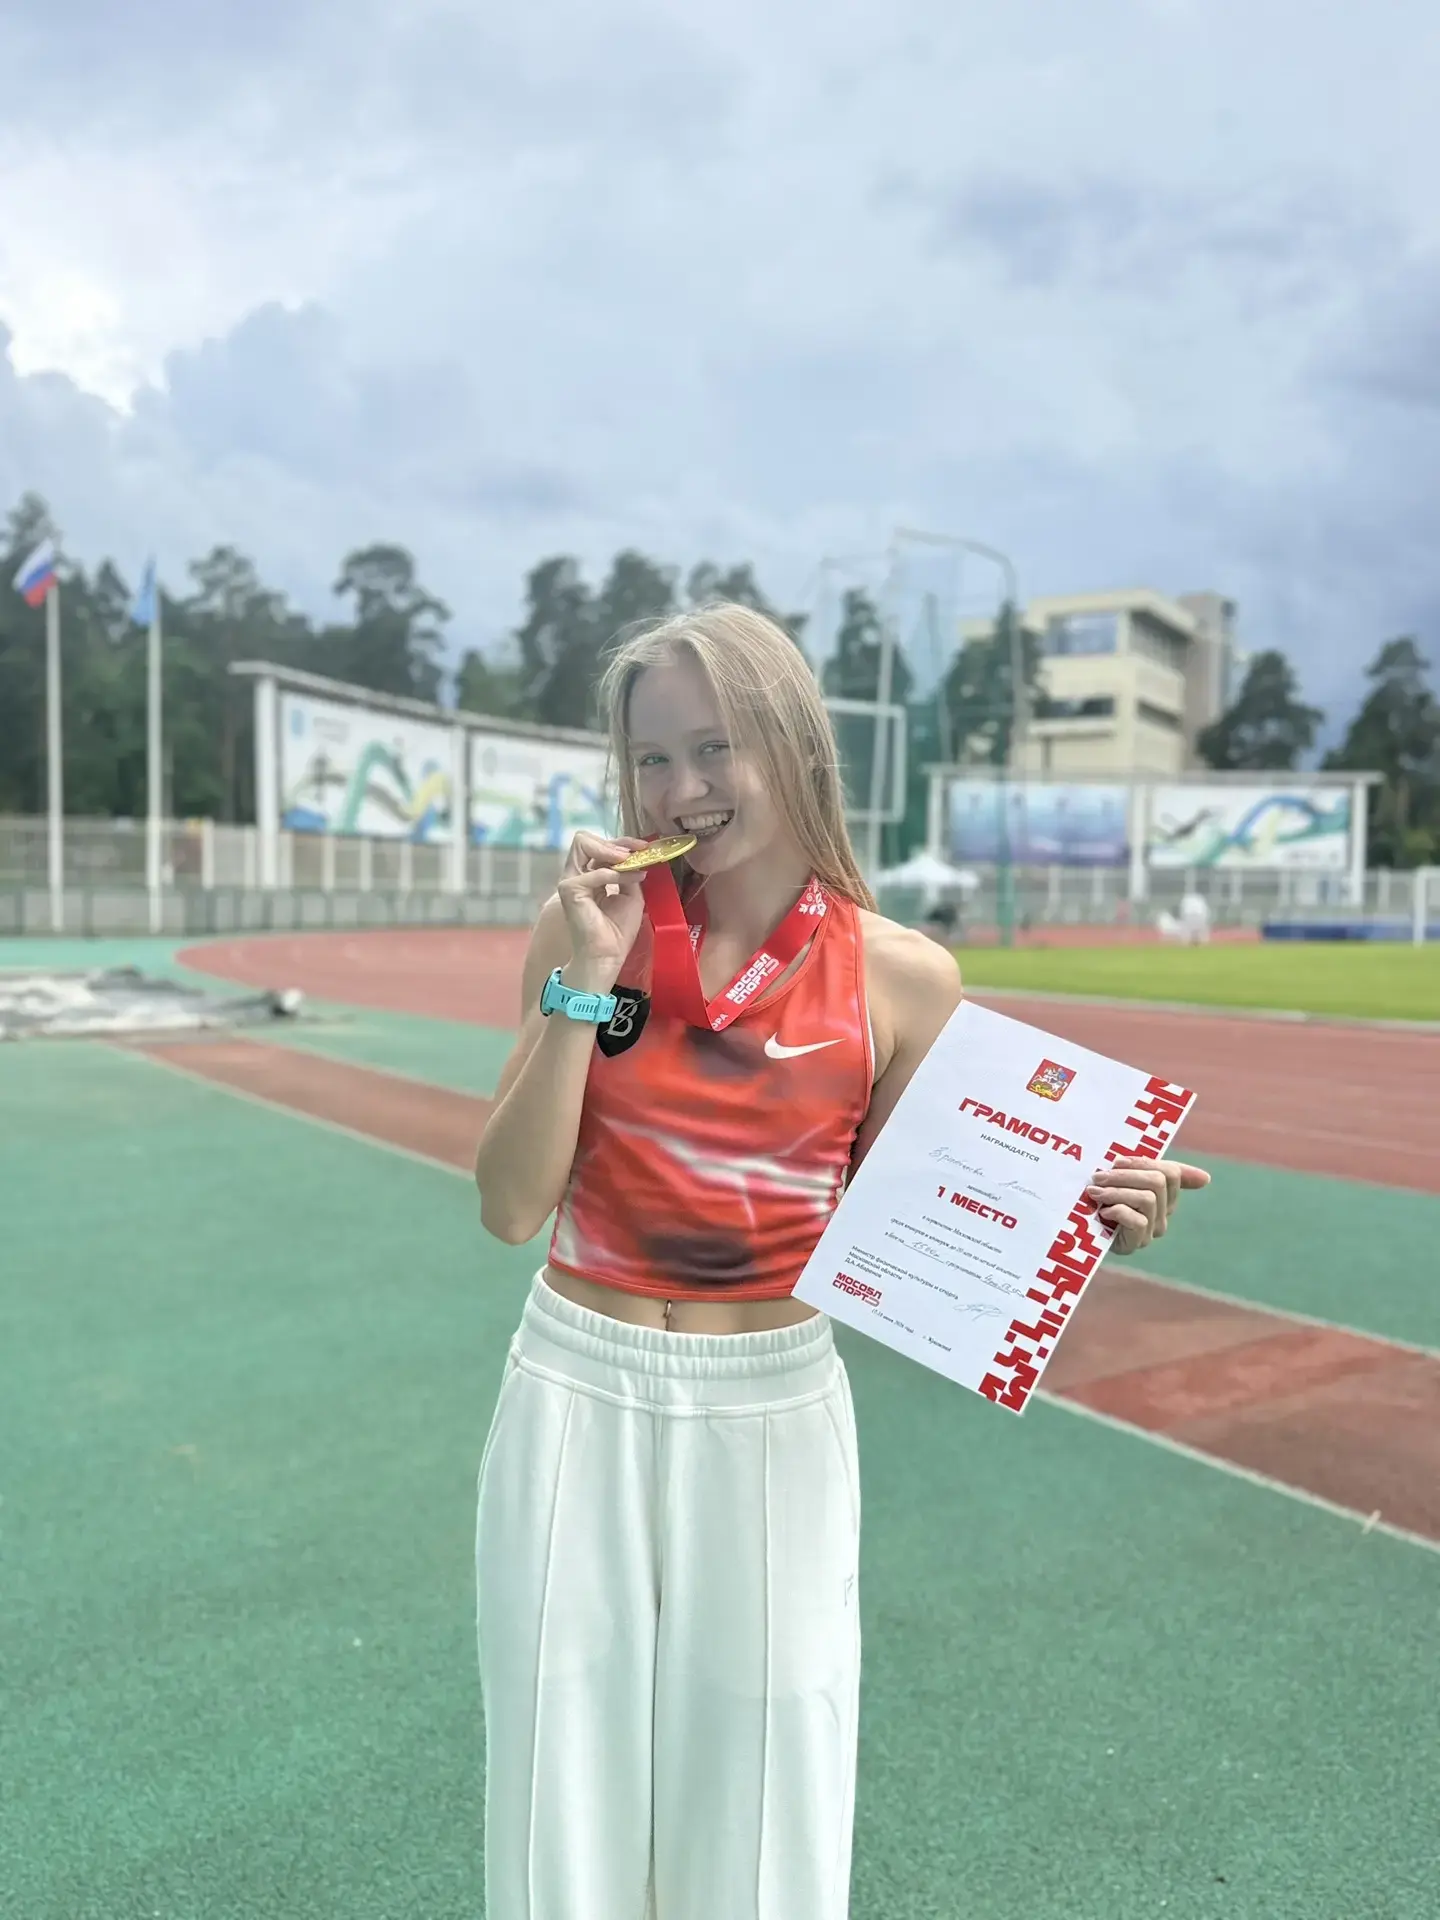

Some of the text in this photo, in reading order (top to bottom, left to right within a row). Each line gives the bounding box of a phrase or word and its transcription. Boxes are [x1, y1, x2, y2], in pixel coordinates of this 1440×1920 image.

[725, 953, 771, 1000] МОСОБЛ
[734, 968, 768, 1004] СПОРТ
[958, 1097, 1082, 1162] ГРАМОТА
[980, 1133, 1040, 1162] НАГРАЖДАЕТСЯ
[937, 1185, 1018, 1229] 1 МЕСТО
[848, 1251, 903, 1281] Московской области
[832, 1279, 869, 1301] СПОРТ
[835, 1271, 882, 1300] МОСОБЛ
[938, 1287, 959, 1300] спорта
